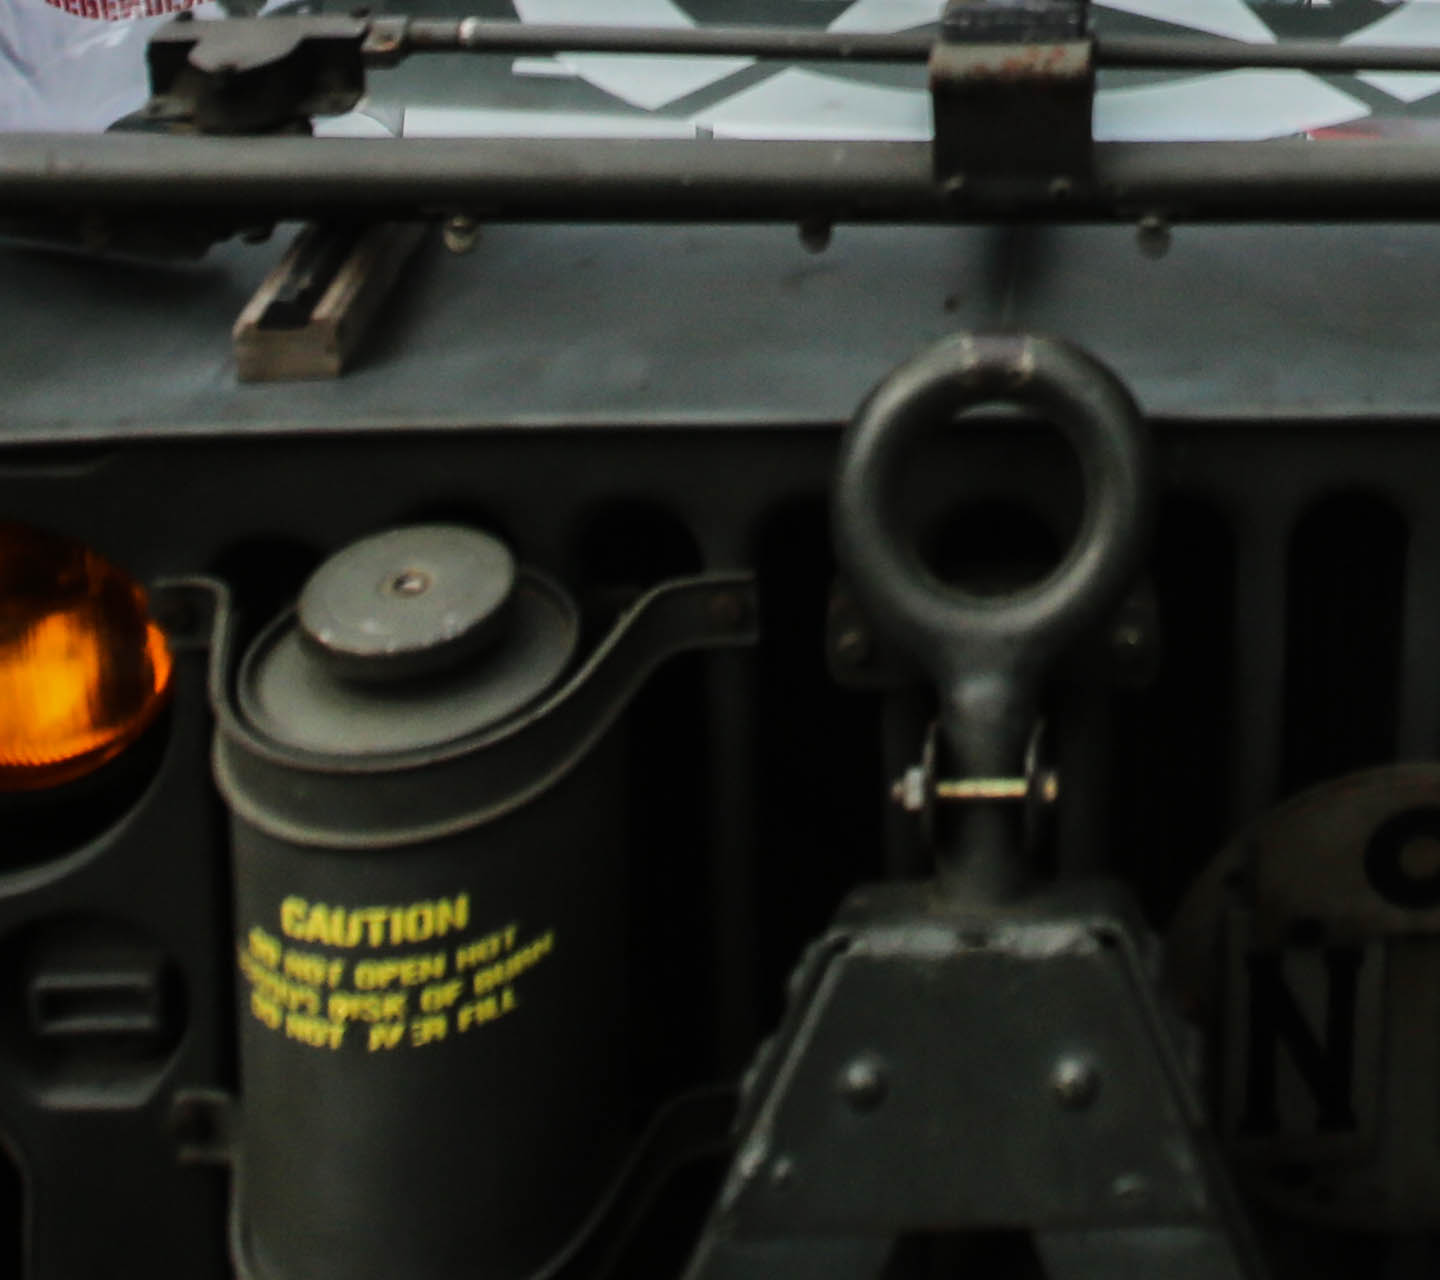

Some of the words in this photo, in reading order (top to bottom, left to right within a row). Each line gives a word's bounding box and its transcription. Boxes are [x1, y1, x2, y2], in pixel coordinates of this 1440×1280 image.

[280, 891, 471, 948] CAUTION
[249, 926, 281, 964] DO
[283, 948, 345, 990] NOT
[354, 952, 447, 991] OPEN
[455, 924, 518, 970] HOT
[420, 978, 464, 1012] OF
[472, 927, 556, 996] BURN
[250, 990, 283, 1030] DO
[285, 1014, 347, 1050] NOT
[1239, 941, 1366, 1133] N
